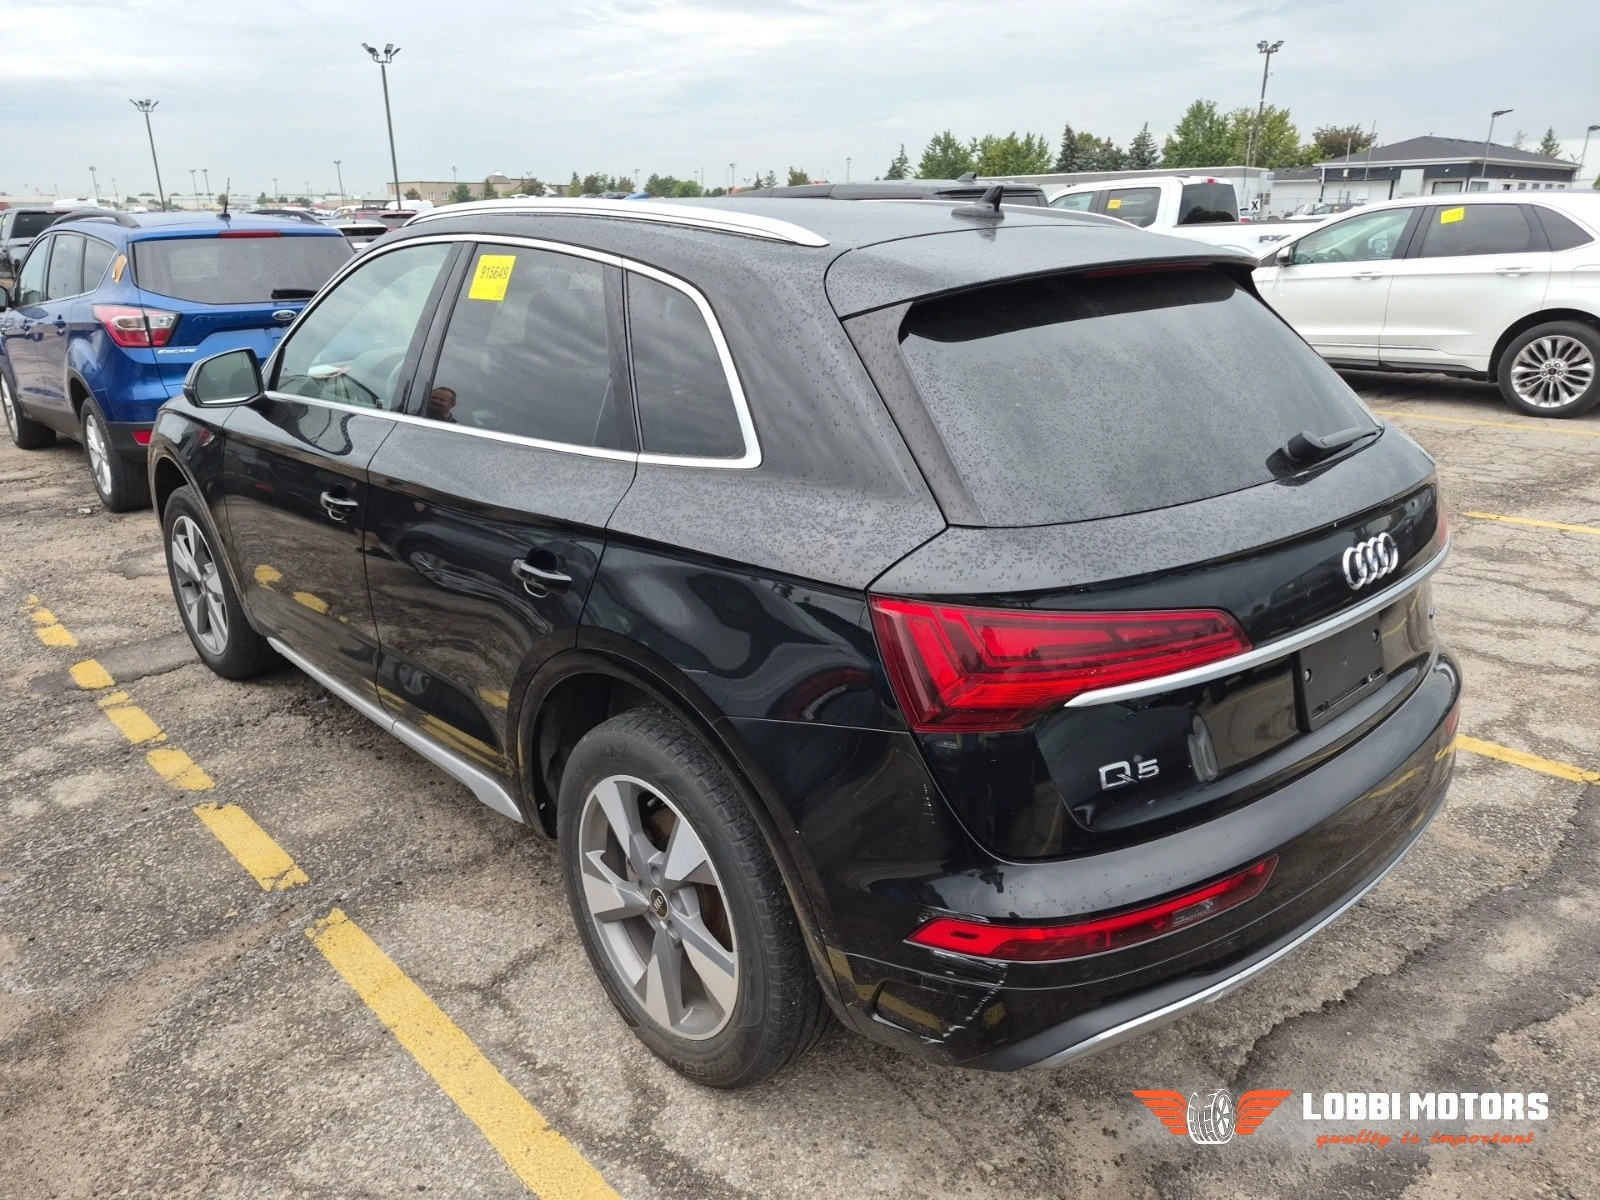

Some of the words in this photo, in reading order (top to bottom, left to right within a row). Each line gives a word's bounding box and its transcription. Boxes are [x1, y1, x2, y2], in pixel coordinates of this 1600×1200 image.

[1251, 201, 1259, 211] X
[480, 266, 509, 279] 915649
[1099, 759, 1159, 789] Q5
